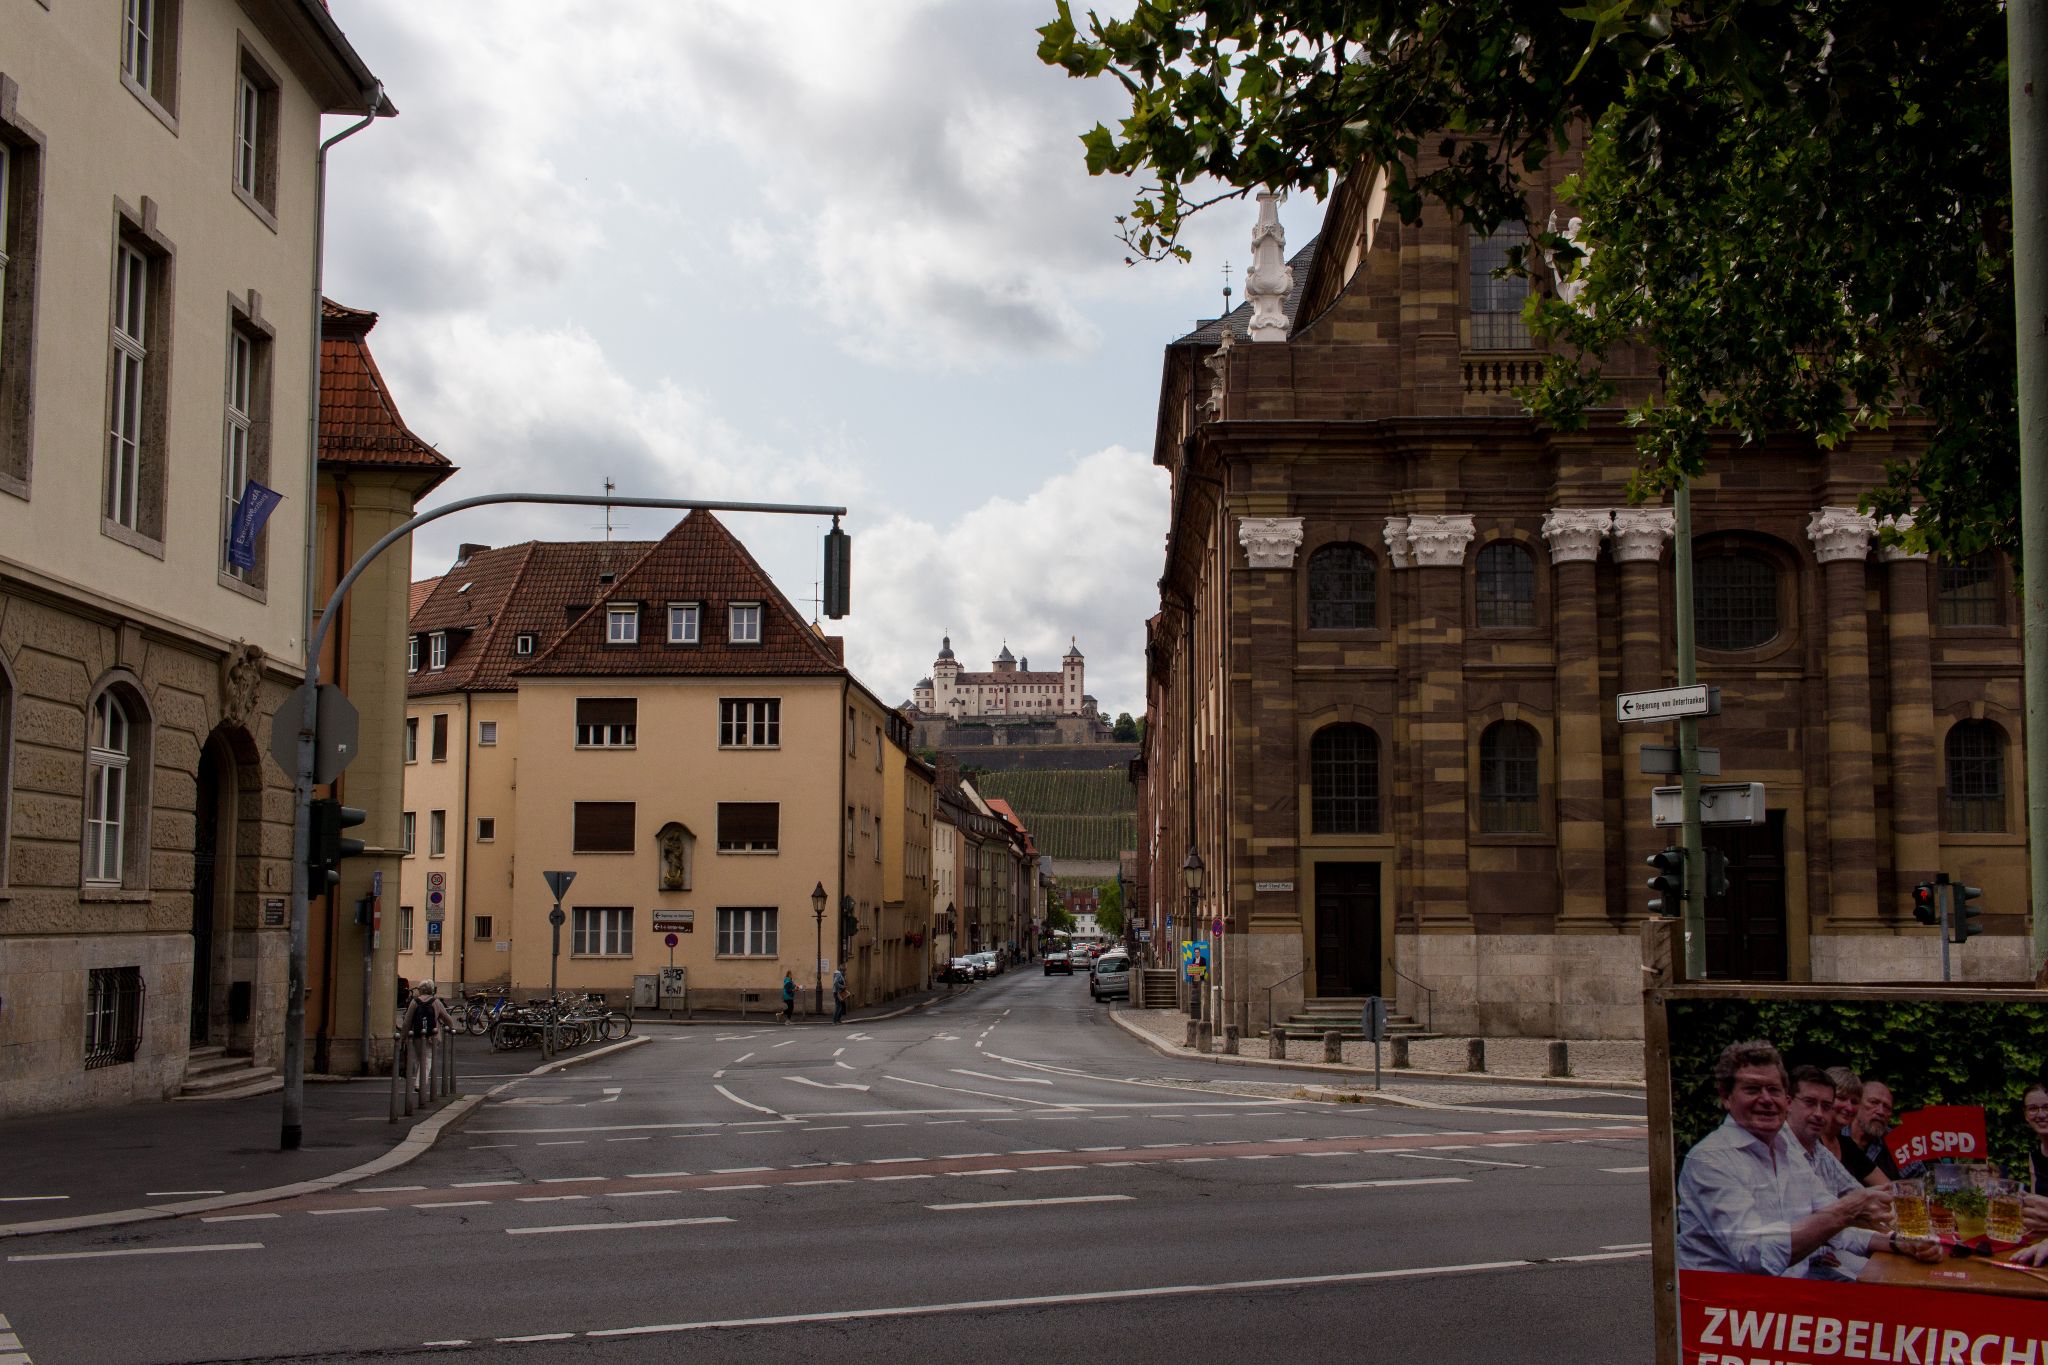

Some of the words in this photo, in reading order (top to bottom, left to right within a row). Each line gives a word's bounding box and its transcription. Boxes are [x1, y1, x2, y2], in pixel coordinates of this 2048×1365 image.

[1635, 701, 1660, 712] Regierung
[1662, 700, 1671, 708] von
[1673, 695, 1705, 706] Unterfranken
[1930, 1130, 1976, 1153] SPD
[1699, 1306, 2048, 1365] ZWIEBELKIRCH
